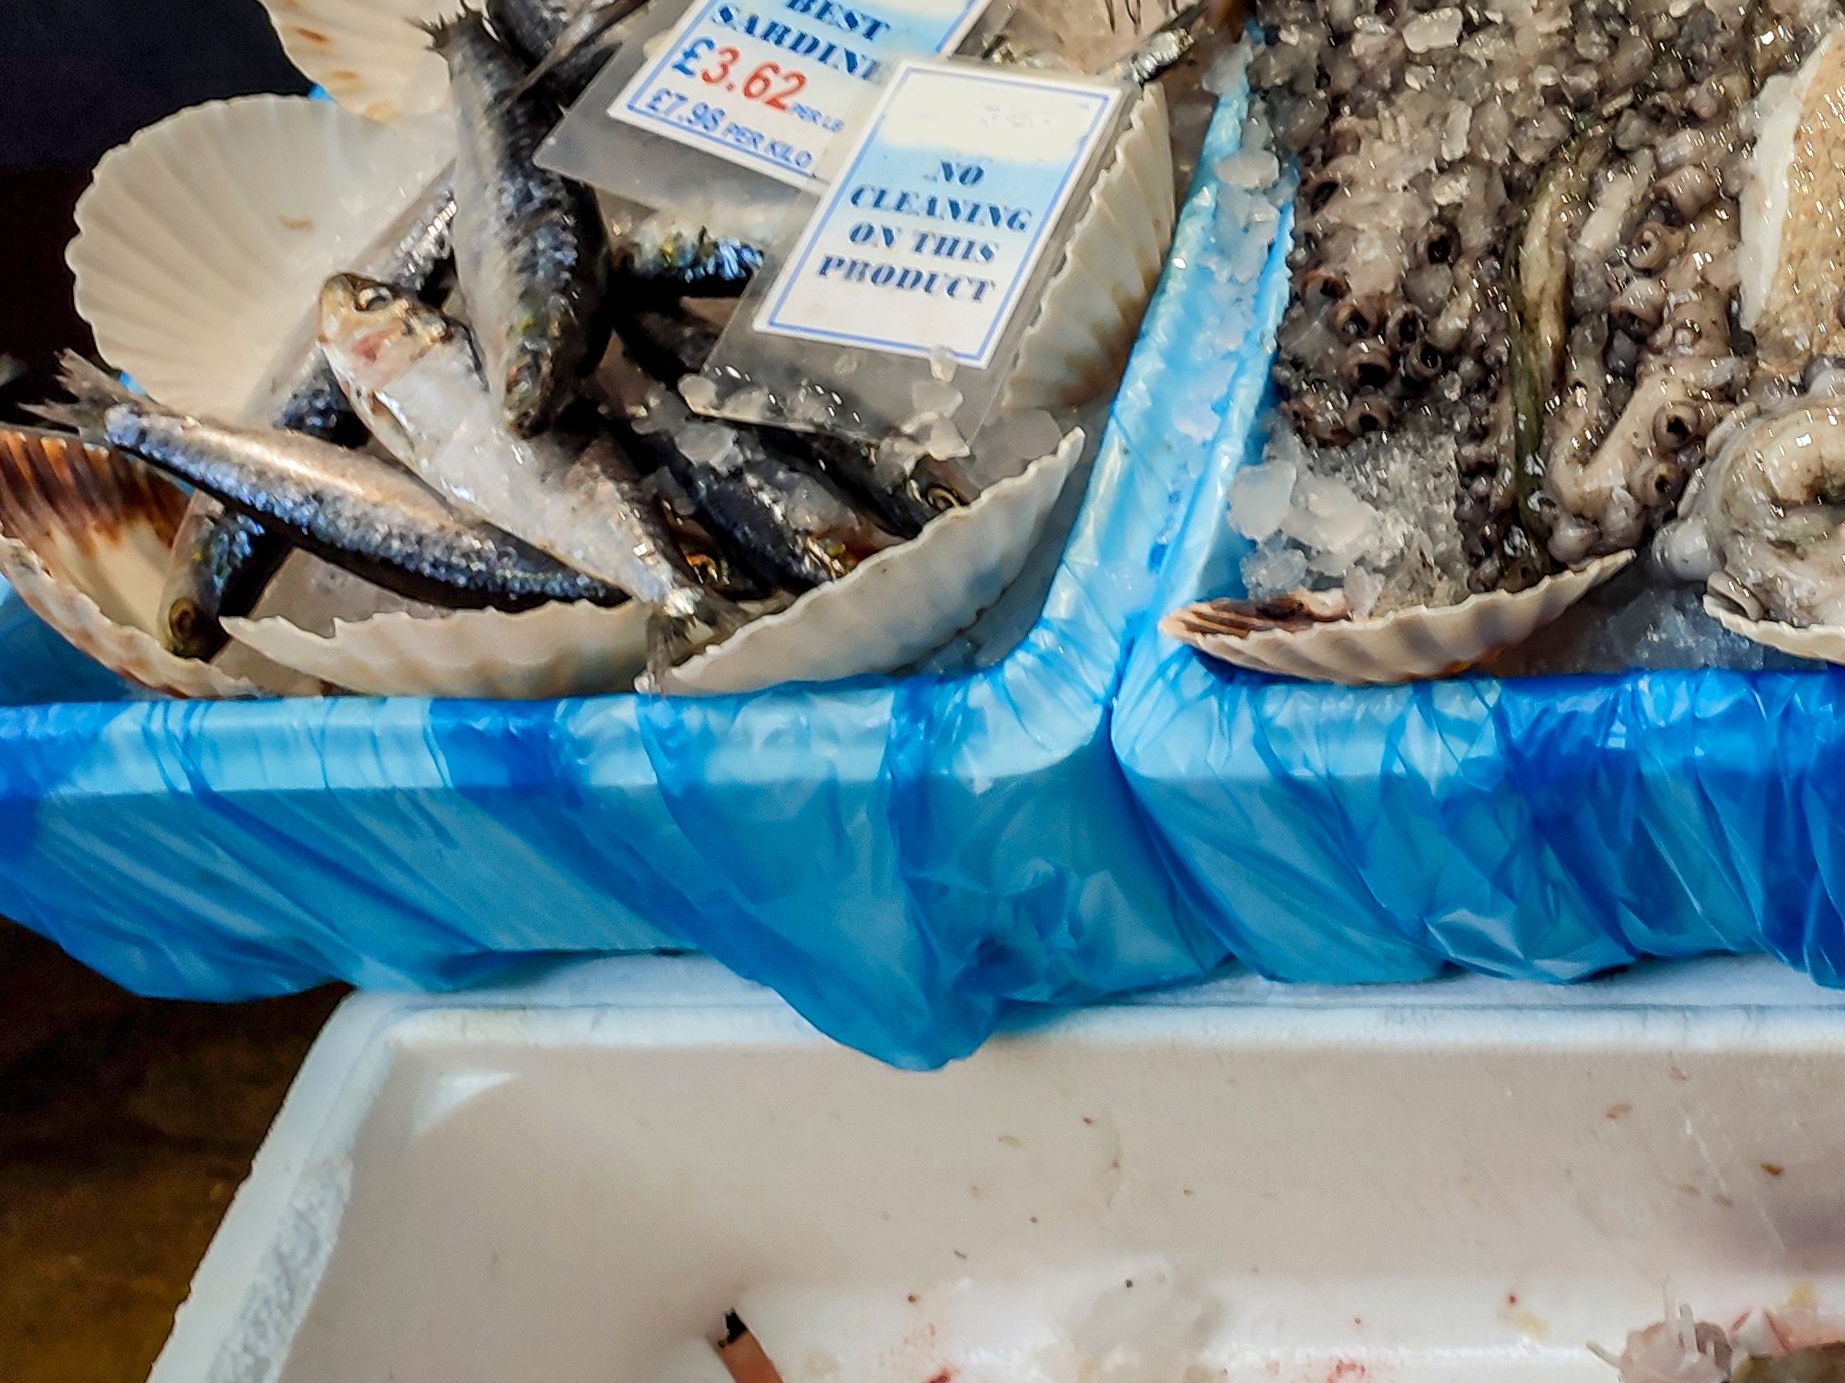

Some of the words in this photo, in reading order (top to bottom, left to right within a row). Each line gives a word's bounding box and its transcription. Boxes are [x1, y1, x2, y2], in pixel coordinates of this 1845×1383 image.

[672, 37, 807, 112] £3.62
[792, 103, 822, 125] PER
[822, 115, 845, 134] LB
[646, 88, 727, 132] £7.98
[722, 122, 765, 151] PER
[764, 138, 813, 168] KILO
[925, 159, 985, 187] NO
[850, 184, 1033, 233] CLEANING
[849, 221, 901, 249] ON
[913, 232, 998, 264] THIS
[817, 255, 997, 303] PRODUCT
